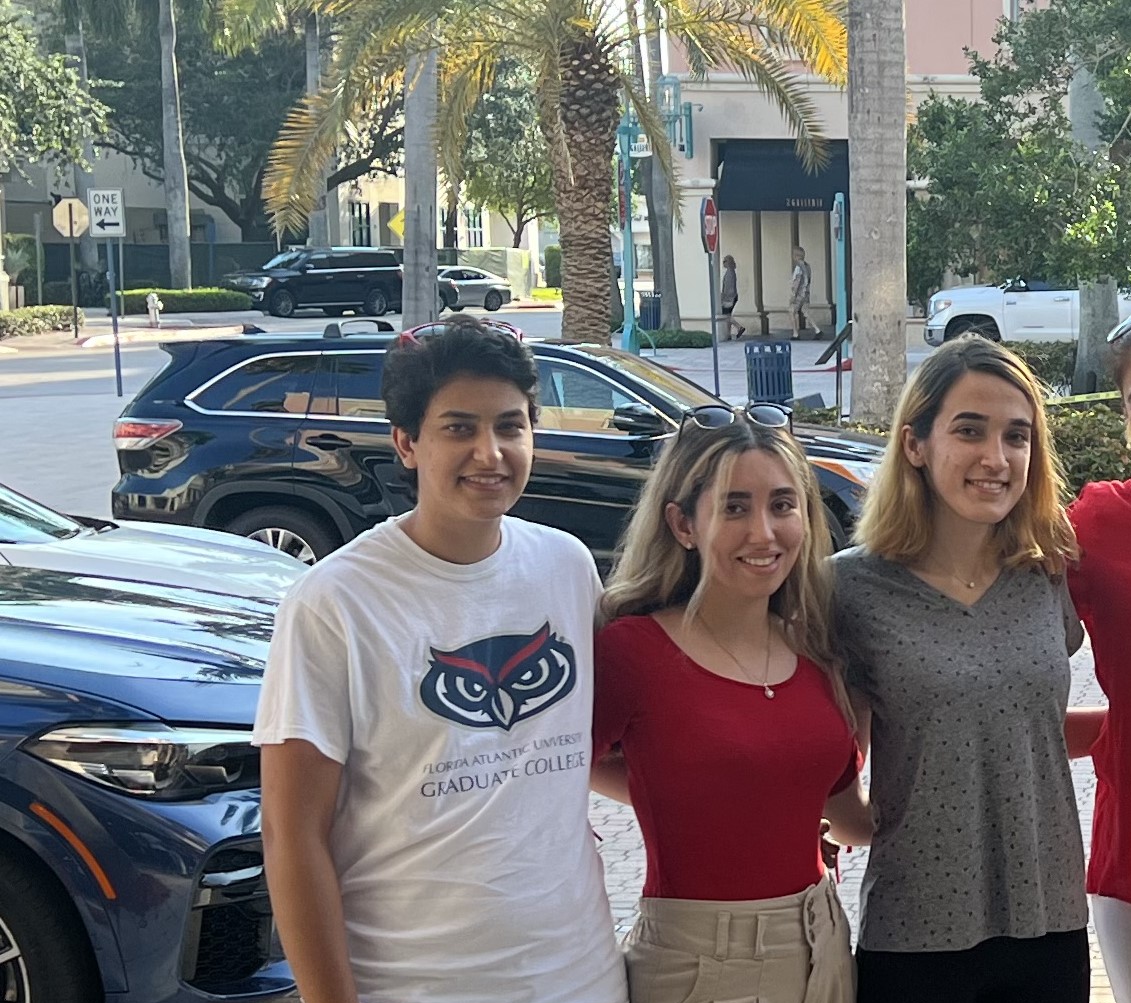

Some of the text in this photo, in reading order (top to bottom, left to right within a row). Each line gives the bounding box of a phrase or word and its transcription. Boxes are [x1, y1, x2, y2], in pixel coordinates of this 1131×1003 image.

[93, 193, 118, 204] ONE
[94, 206, 118, 217] WAY
[471, 743, 530, 767] ATLANTIC
[420, 751, 586, 798] GRADUATE COLLEGE
